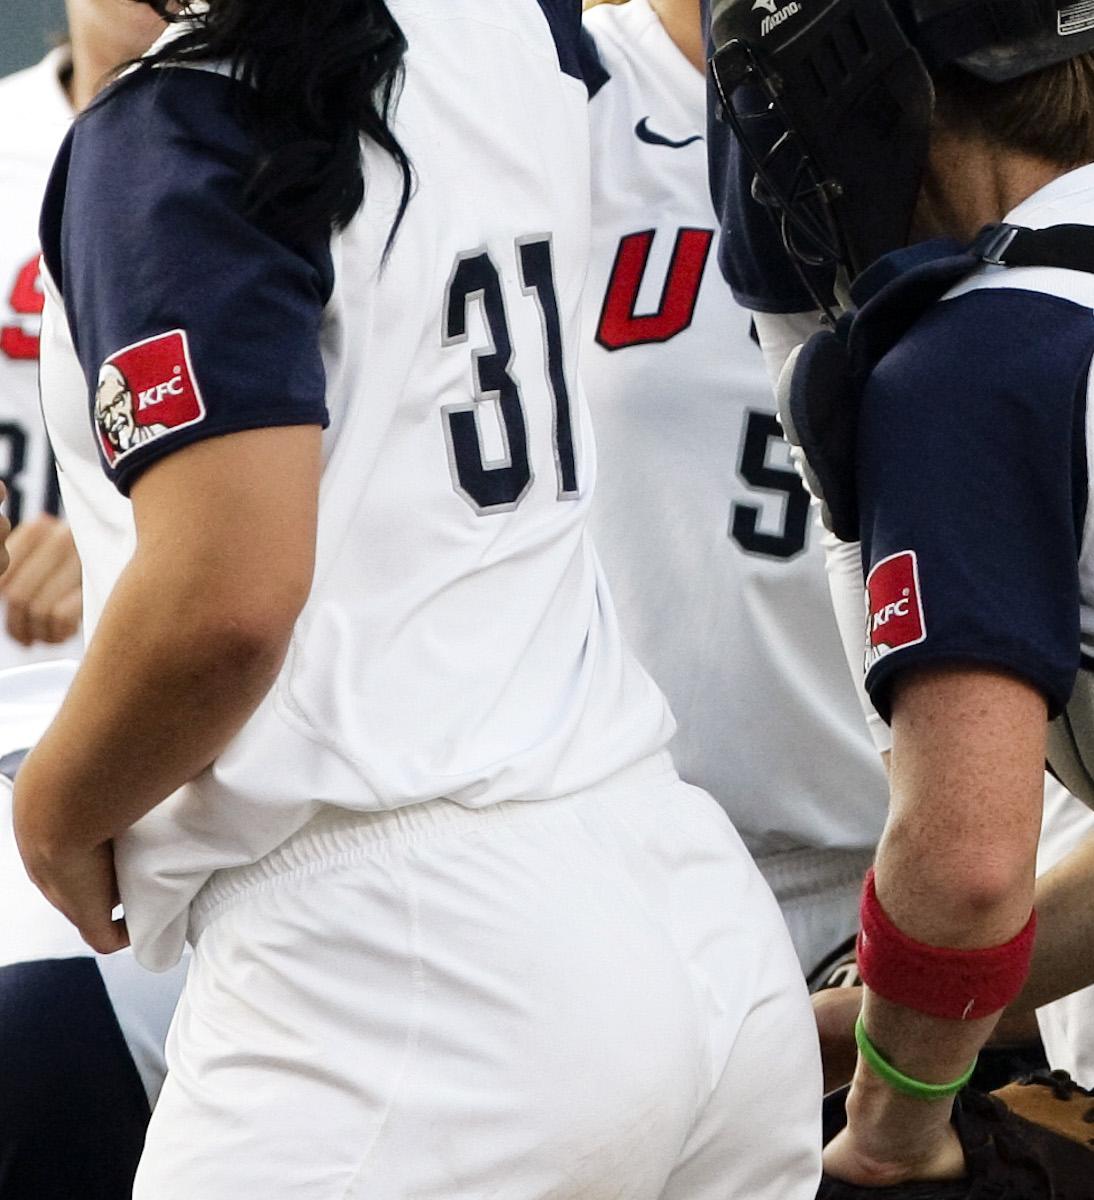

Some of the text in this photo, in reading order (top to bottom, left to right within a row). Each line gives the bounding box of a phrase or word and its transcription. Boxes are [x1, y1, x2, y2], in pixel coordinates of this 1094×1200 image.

[595, 228, 763, 352] U
[138, 375, 184, 411] KFC
[442, 231, 580, 517] 31
[727, 405, 814, 563] 5
[872, 598, 910, 633] KFC
